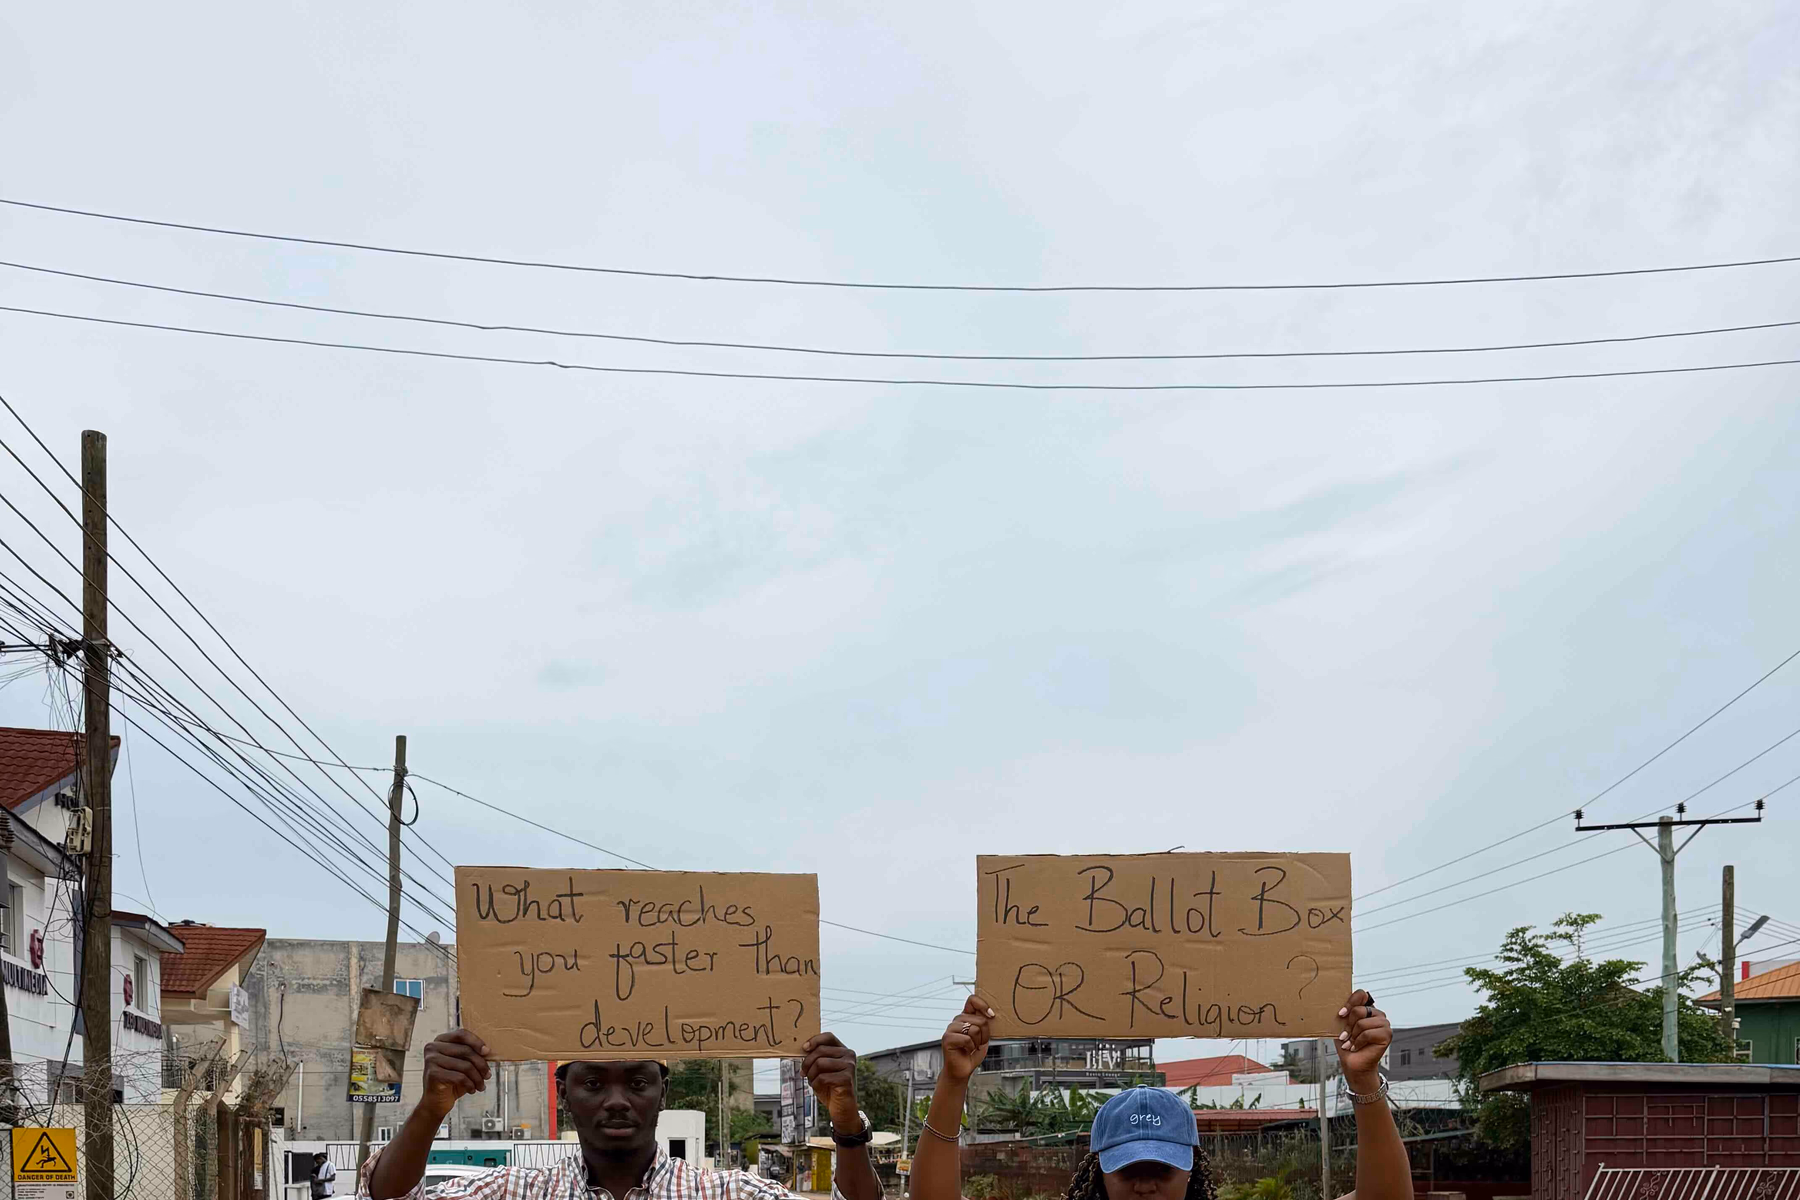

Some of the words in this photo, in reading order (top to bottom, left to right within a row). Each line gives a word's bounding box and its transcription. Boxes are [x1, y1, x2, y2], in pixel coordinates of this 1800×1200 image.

[472, 876, 584, 925] What
[616, 885, 756, 927] reaches
[984, 863, 1049, 926] The
[1075, 864, 1222, 938] Ballot
[1237, 866, 1345, 936] Box
[503, 948, 581, 997] you
[608, 930, 719, 1001] faster
[1012, 961, 1106, 1025] OR
[579, 996, 804, 1052] development?
[1129, 1113, 1161, 1126] grey
